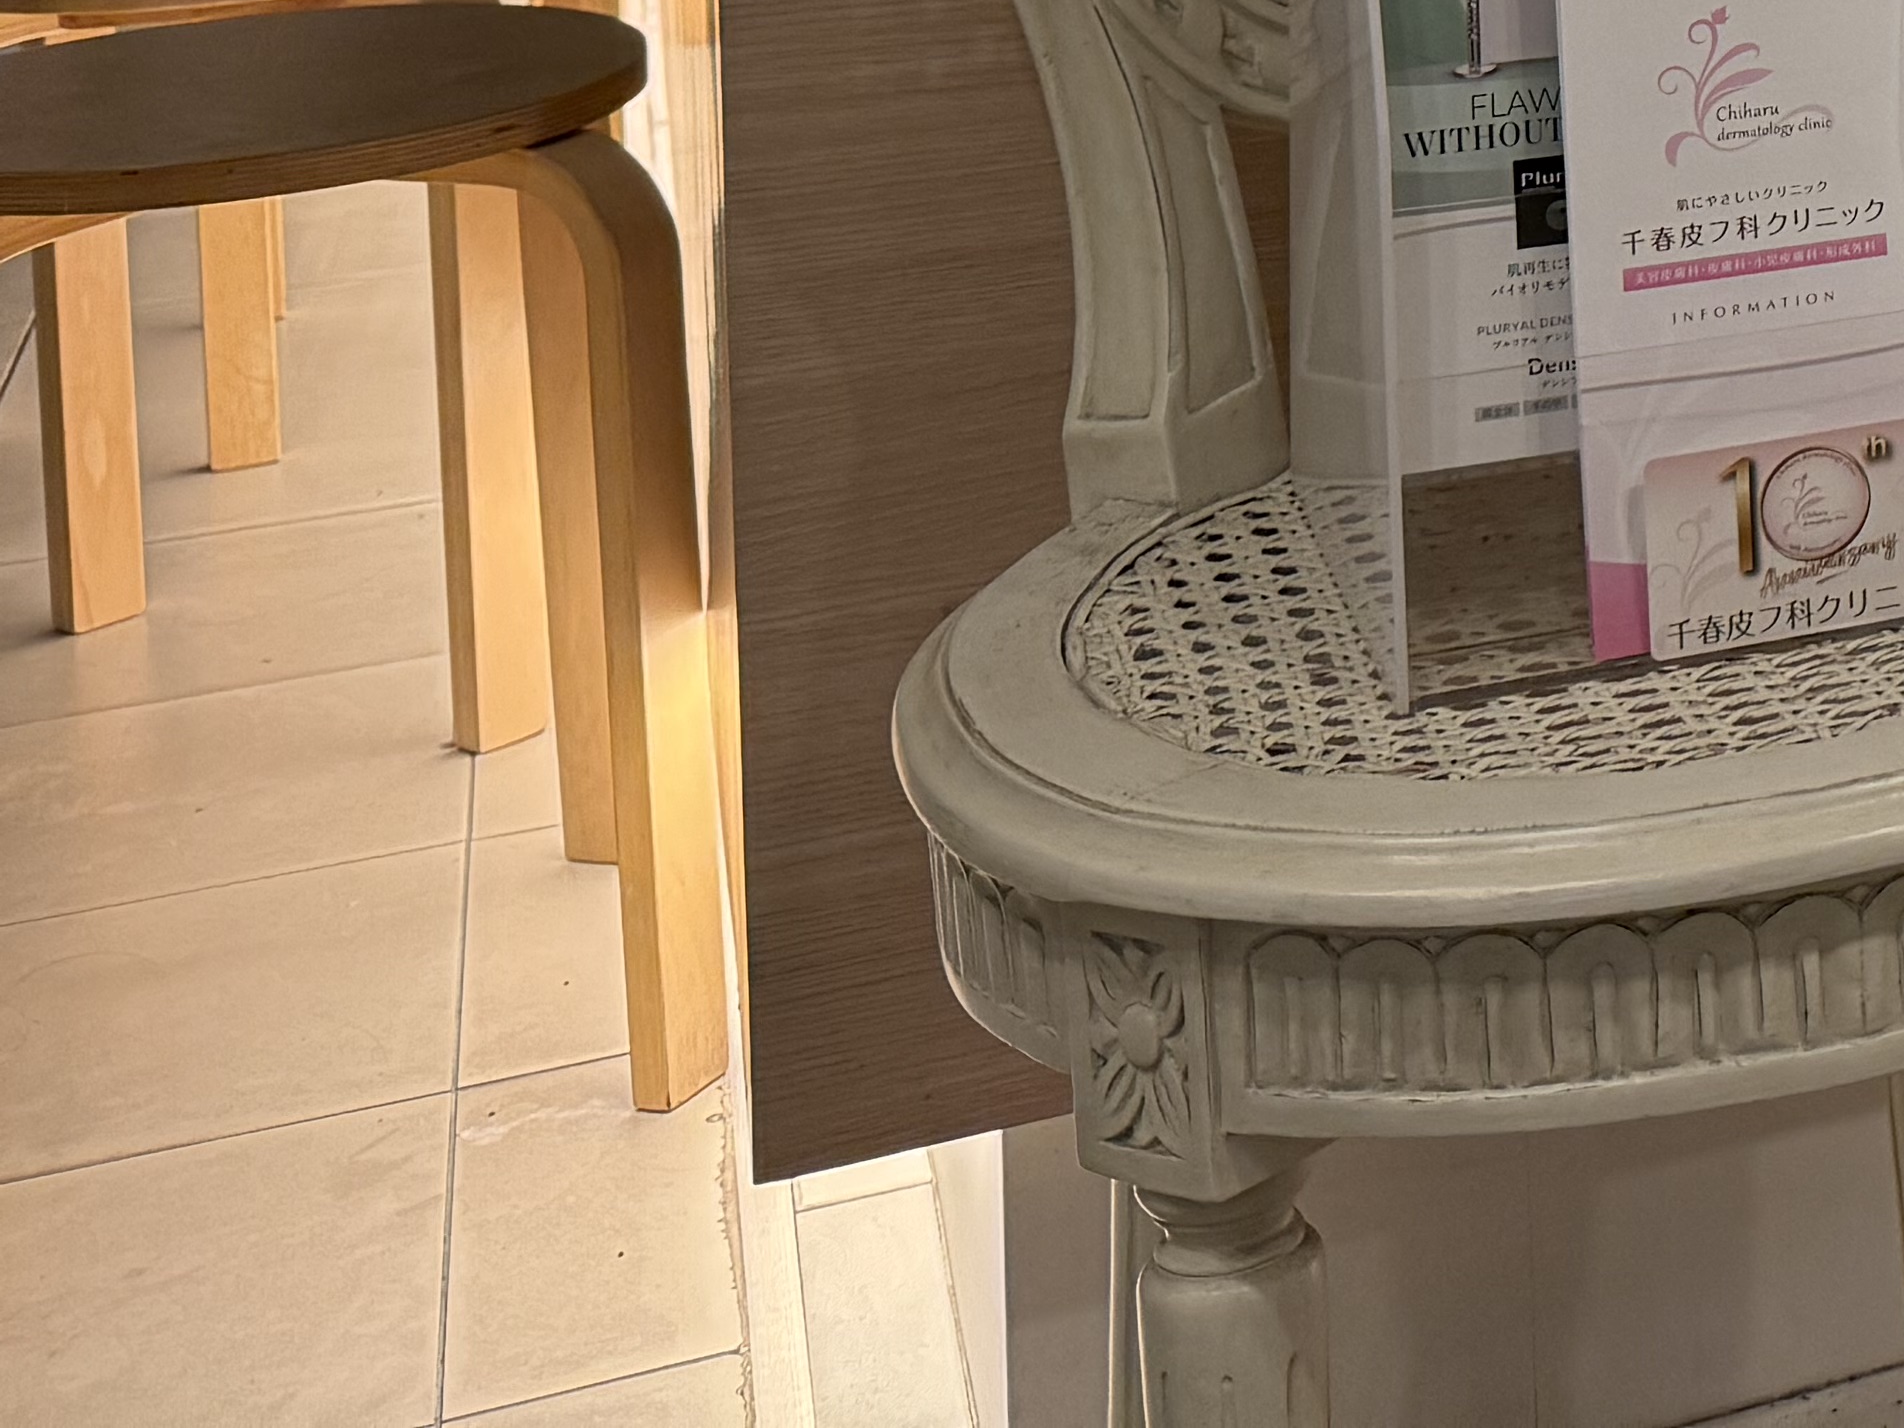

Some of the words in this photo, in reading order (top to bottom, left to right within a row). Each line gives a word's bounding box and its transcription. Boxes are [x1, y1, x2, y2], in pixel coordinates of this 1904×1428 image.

[1716, 101, 1780, 123] Chiharu
[1404, 116, 1562, 159] WITHOUT
[1717, 120, 1795, 142] dermatology
[1798, 116, 1834, 132] clinic
[1676, 180, 1828, 212] 肌にやさしいクリニック
[1620, 198, 1885, 256] 千春皮フ科クリニック
[1672, 290, 1836, 325] INFORMATION
[1476, 317, 1536, 337] PLURYAL
